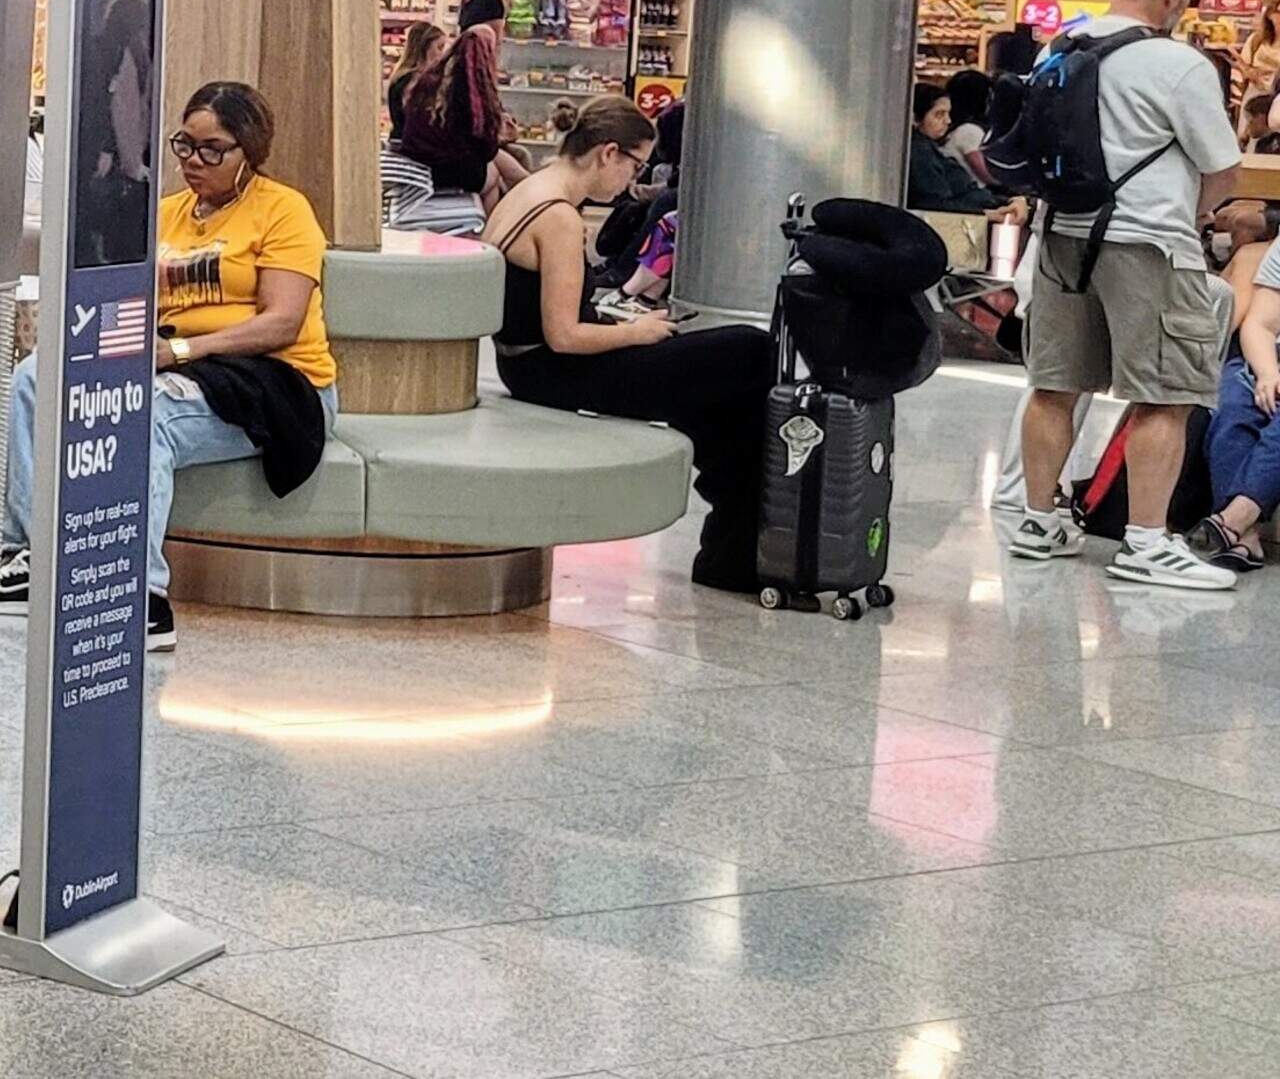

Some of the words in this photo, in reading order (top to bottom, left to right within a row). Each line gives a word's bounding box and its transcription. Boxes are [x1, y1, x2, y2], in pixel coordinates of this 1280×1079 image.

[1024, 5, 1035, 20] 3
[1049, 5, 1059, 20] 2
[69, 382, 122, 429] Flying
[125, 381, 143, 412] to
[67, 435, 117, 479] USA?
[65, 512, 83, 532] Sign
[83, 512, 94, 528] up
[95, 506, 105, 522] for
[64, 537, 86, 554] alerts
[88, 532, 99, 548] for
[99, 530, 118, 550] your
[71, 563, 97, 584] Simply
[98, 562, 116, 577] scan
[117, 556, 130, 572] the
[75, 588, 94, 608] code
[94, 584, 109, 602] and
[110, 584, 125, 603] you
[64, 615, 92, 634] receive
[93, 614, 98, 627] a
[100, 605, 133, 623] message
[72, 639, 93, 656] when
[107, 631, 125, 651] your
[64, 667, 81, 683] time
[82, 664, 90, 677] to
[91, 651, 122, 679] proceed
[123, 652, 131, 665] to
